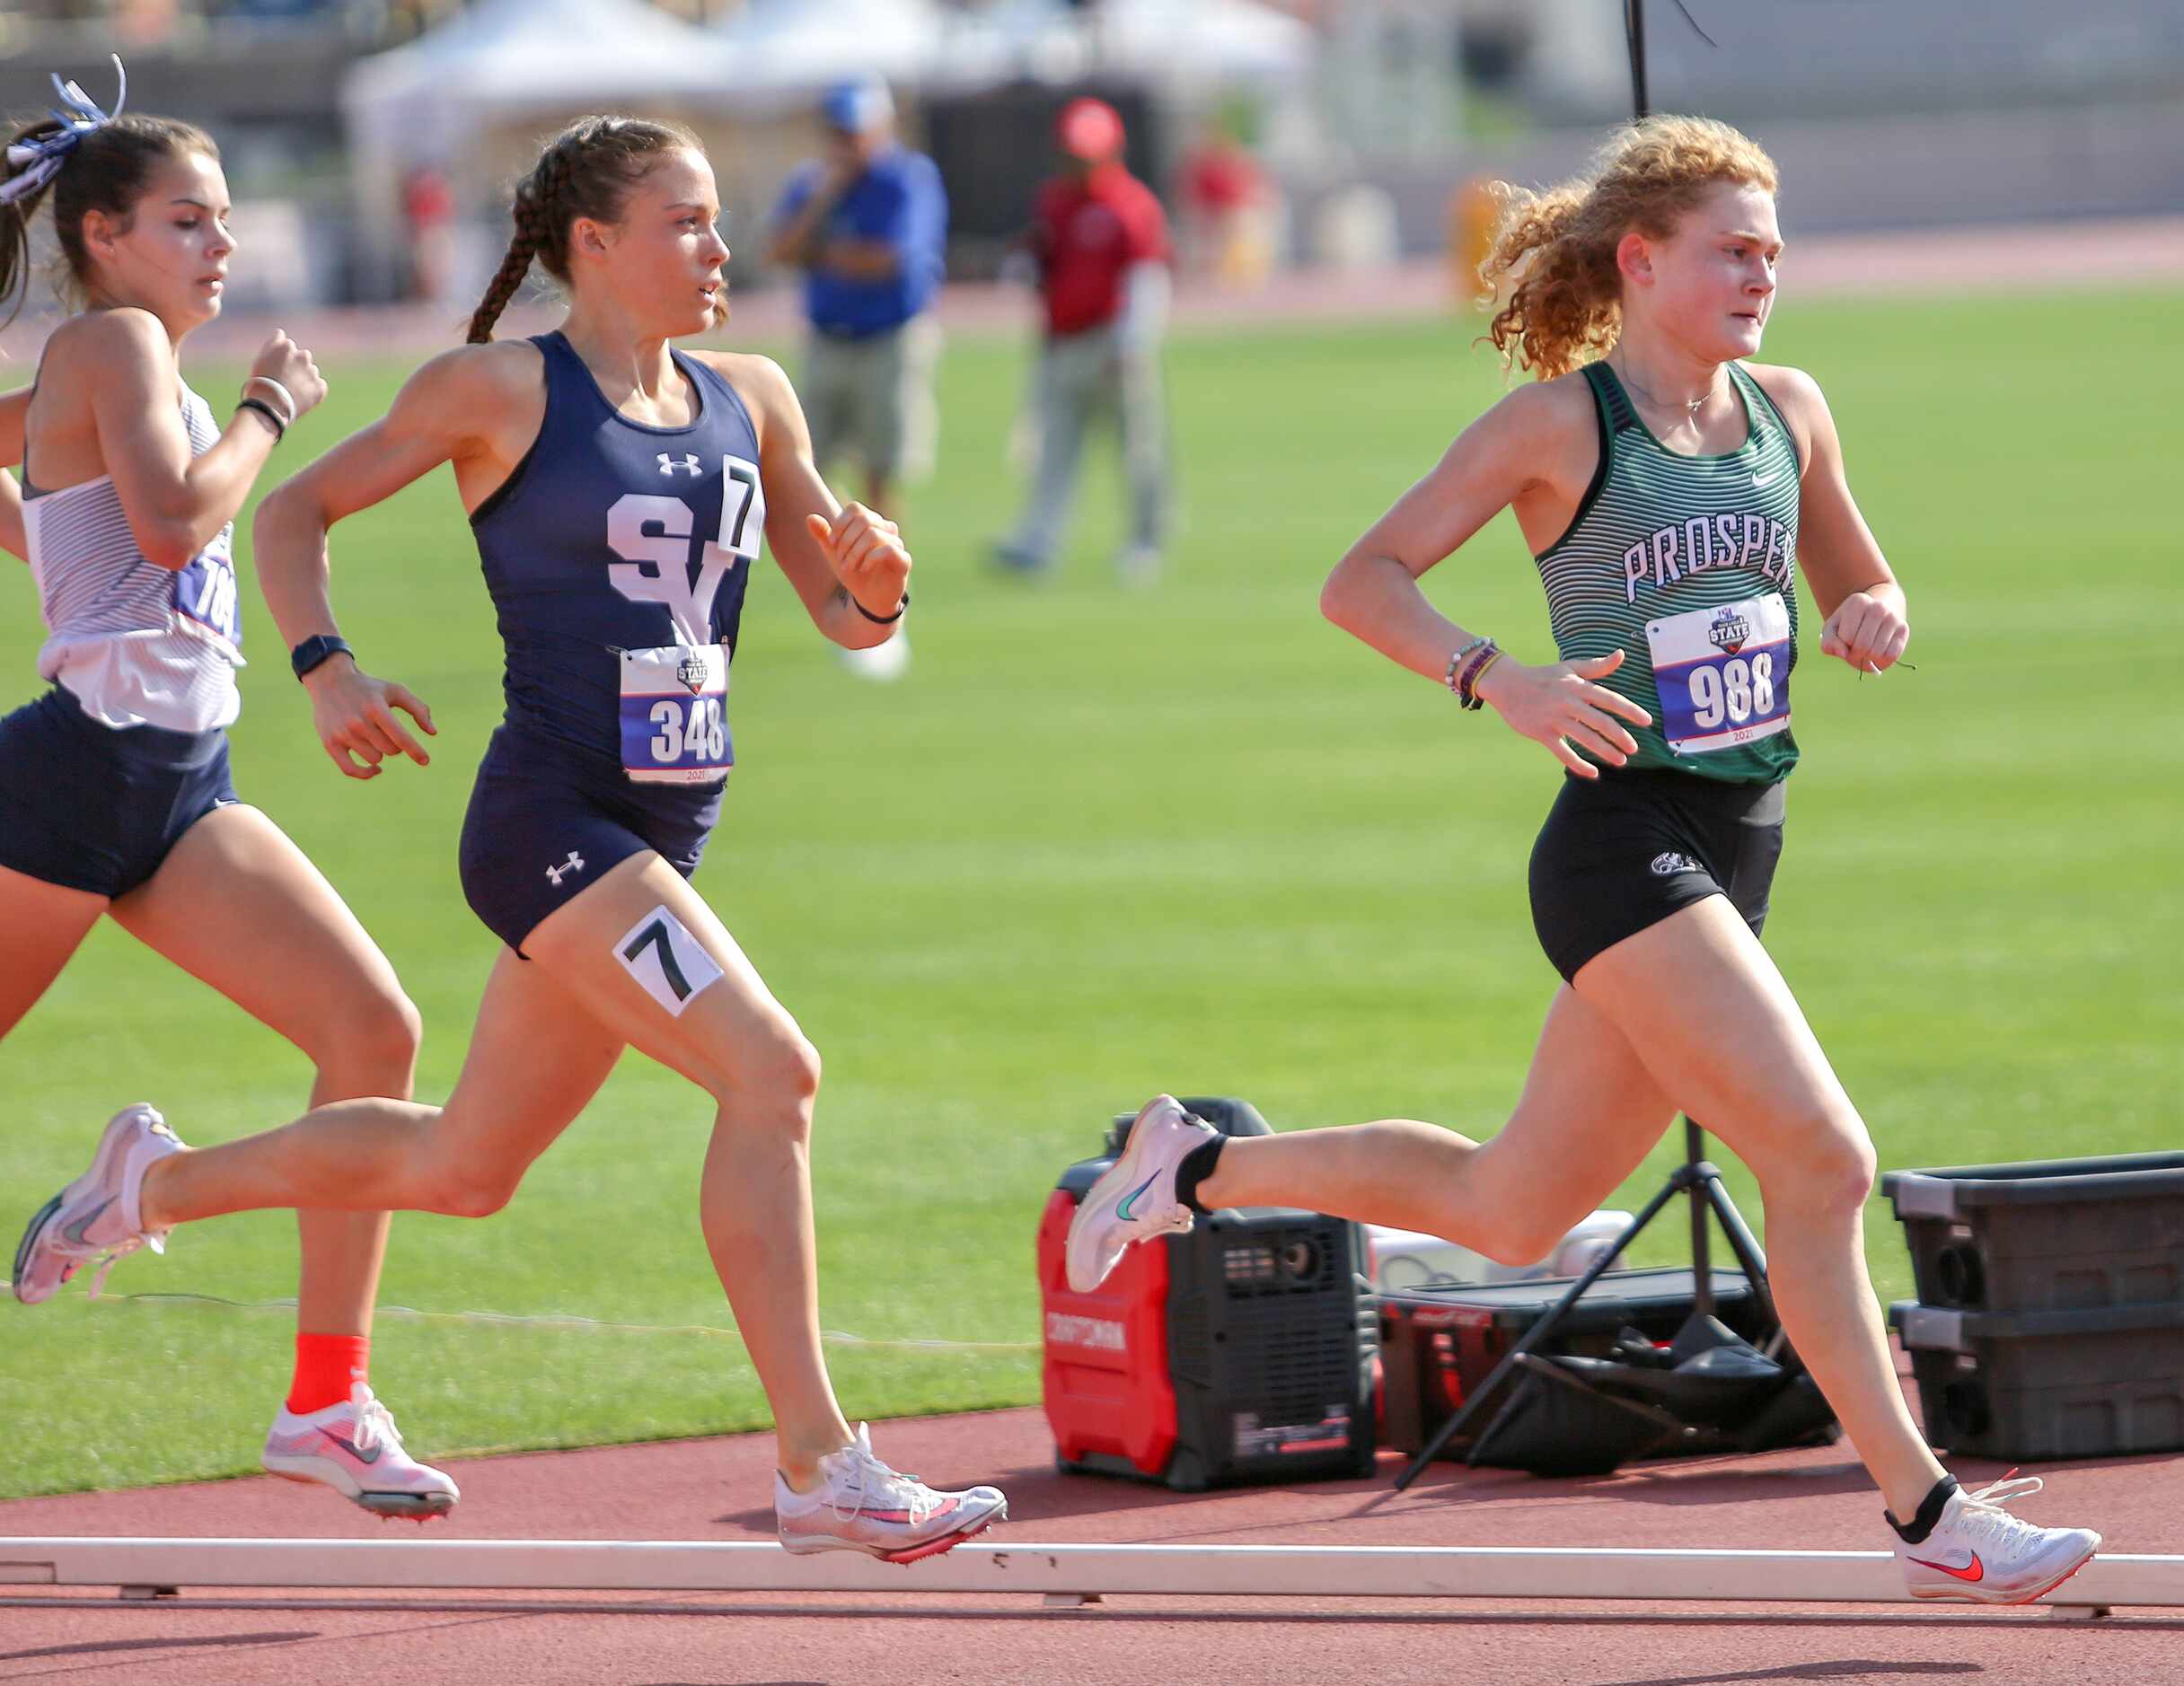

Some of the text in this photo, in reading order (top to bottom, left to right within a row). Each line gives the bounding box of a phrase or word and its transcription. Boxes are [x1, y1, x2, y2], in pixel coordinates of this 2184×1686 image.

[729, 465, 755, 548] 7
[607, 493, 736, 645] SV
[1709, 623, 1748, 642] STATE
[677, 666, 708, 681] STATE
[1688, 652, 1774, 728] 988
[648, 698, 724, 762] 348
[1733, 729, 1754, 742] 2021
[687, 770, 705, 780] 2021
[621, 918, 693, 1002] 7
